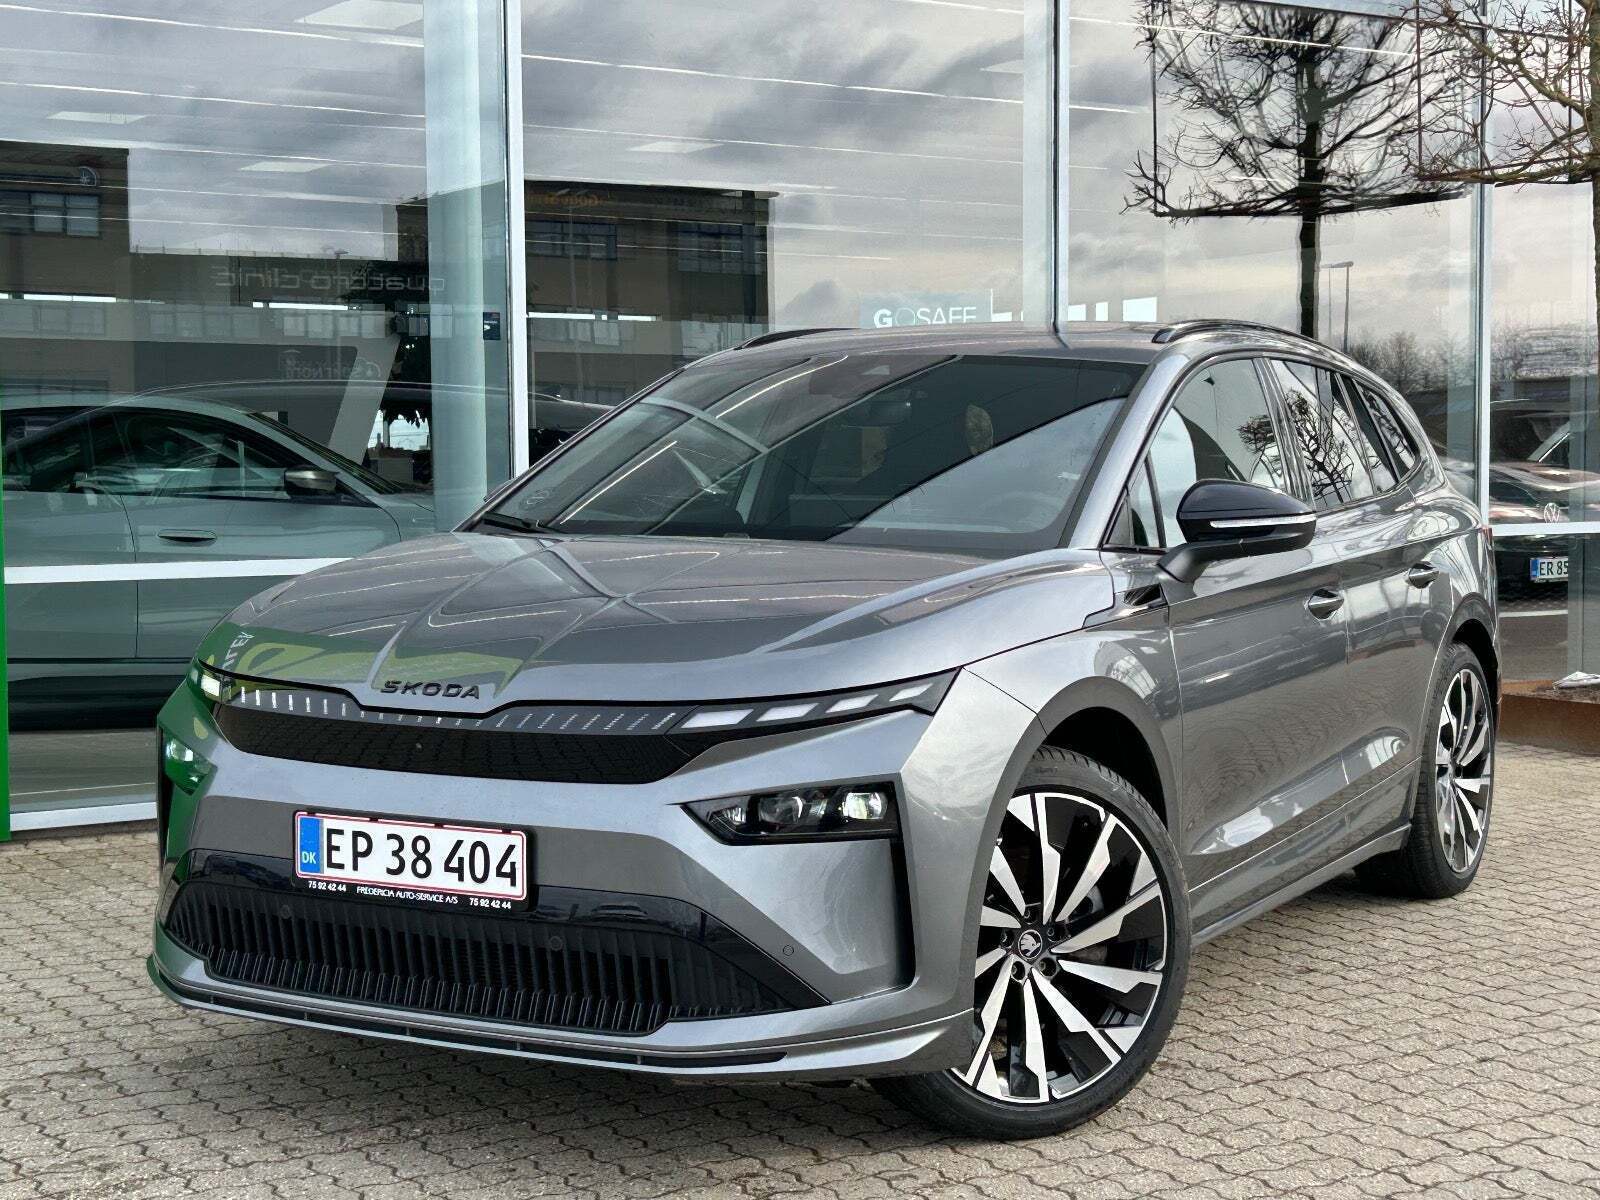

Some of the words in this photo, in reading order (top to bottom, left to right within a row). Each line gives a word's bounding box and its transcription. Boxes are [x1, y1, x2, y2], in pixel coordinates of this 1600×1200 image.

[873, 306, 977, 328] GOSAFE
[1539, 561, 1554, 576] ER
[301, 851, 317, 865] DK
[326, 827, 374, 872] EP
[385, 833, 432, 879] 38
[443, 839, 517, 888] 404
[308, 880, 317, 889] 75
[327, 882, 337, 892] 42
[337, 884, 347, 892] 44
[356, 885, 395, 898] FREDERICIA
[469, 897, 479, 906] 75
[490, 899, 501, 909] 42
[501, 901, 512, 909] 44
